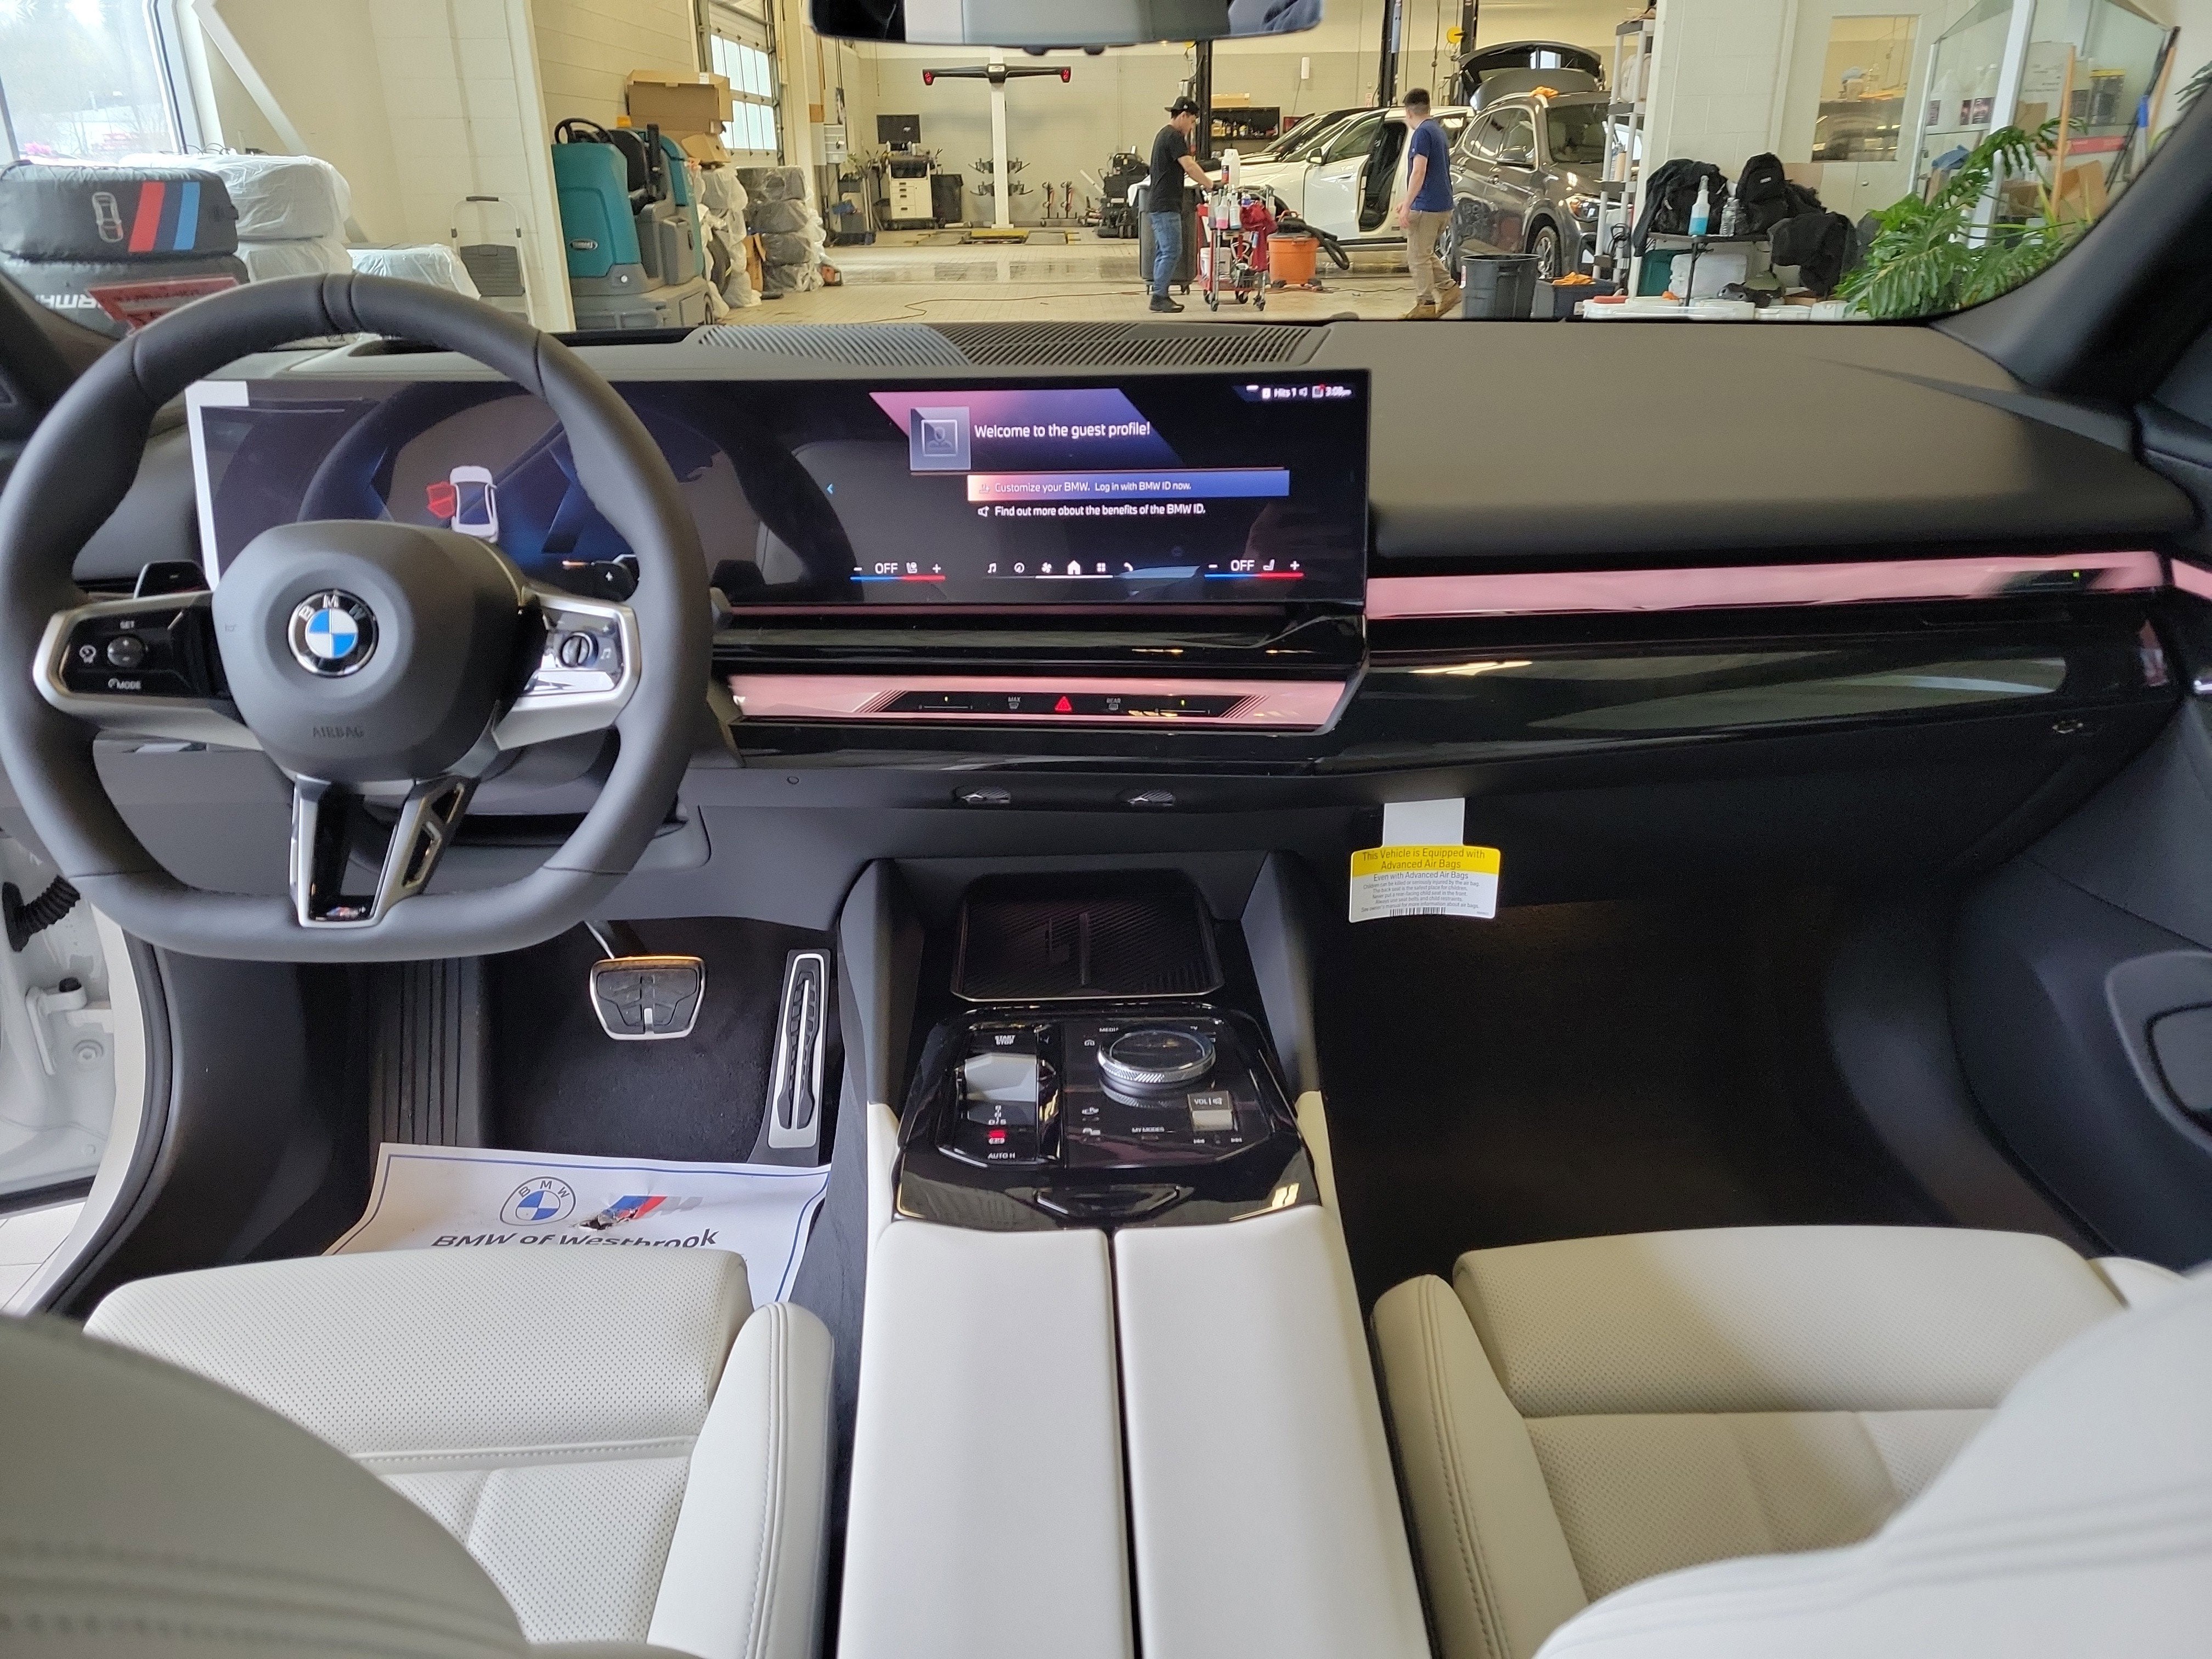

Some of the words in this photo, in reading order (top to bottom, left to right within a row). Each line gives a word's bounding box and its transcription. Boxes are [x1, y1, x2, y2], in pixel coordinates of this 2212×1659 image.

[974, 425, 1030, 438] Welcome
[1034, 425, 1045, 437] to
[1048, 424, 1068, 437] the
[1071, 424, 1106, 439] guest
[1108, 421, 1150, 438] profile!
[995, 483, 1040, 492] Customize
[1043, 483, 1062, 494] your
[1064, 482, 1090, 492] BMW.
[1095, 482, 1110, 493] Log
[1111, 482, 1119, 491] in
[1121, 482, 1137, 491] with
[1139, 481, 1160, 490] BMW
[1162, 481, 1171, 490] ID
[995, 505, 1015, 516] Find
[1016, 506, 1031, 516] out
[1032, 507, 1056, 516] more
[1058, 505, 1084, 516] about
[1086, 505, 1100, 515] the
[1102, 504, 1138, 515] benefits
[1139, 504, 1149, 515] of
[1150, 504, 1165, 515] the
[1166, 504, 1192, 515] BMW
[1193, 503, 1206, 514] ID.
[875, 562, 898, 574] OFF
[1231, 560, 1255, 571] OFF
[313, 727, 363, 738] AIRBAG
[1363, 850, 1378, 861] This
[1380, 848, 1410, 859] Vehicle
[1423, 848, 1464, 858] Equipped
[1466, 849, 1485, 859] with
[1381, 860, 1422, 870] Advanced
[1424, 859, 1436, 867] Air
[1439, 859, 1461, 870] Bags
[1452, 871, 1468, 880] Bags
[518, 1180, 570, 1198] BMW
[431, 1232, 518, 1248] BMW
[520, 1234, 556, 1245] of
[560, 1228, 719, 1248] Westbrook
